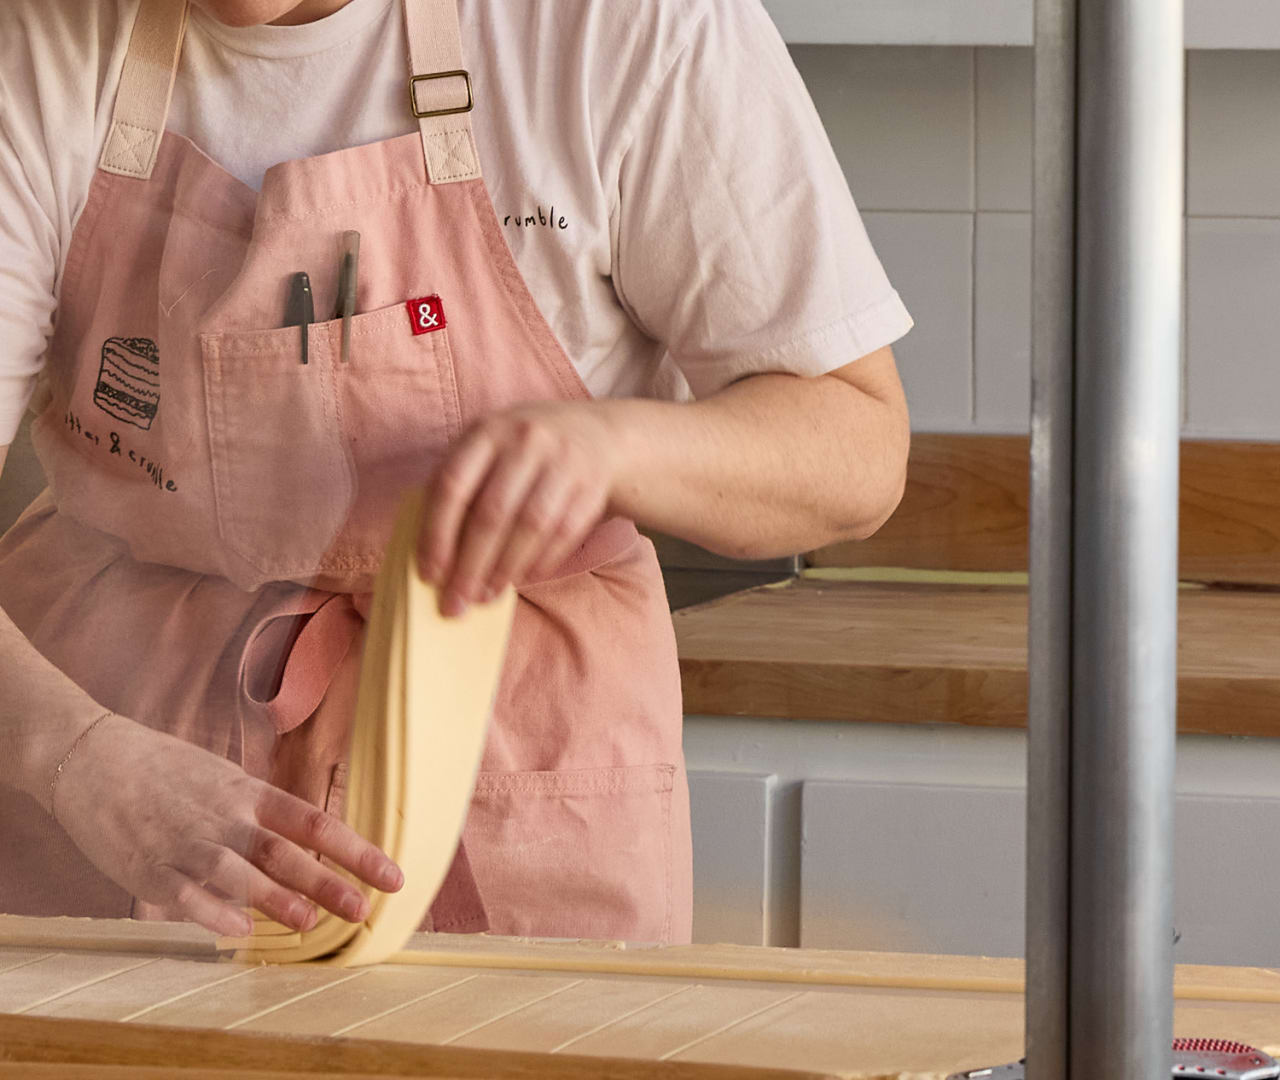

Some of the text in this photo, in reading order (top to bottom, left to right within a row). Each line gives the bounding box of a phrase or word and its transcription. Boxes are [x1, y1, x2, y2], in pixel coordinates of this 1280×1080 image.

[504, 205, 569, 230] rumble
[418, 303, 439, 328] &
[109, 431, 121, 457] &
